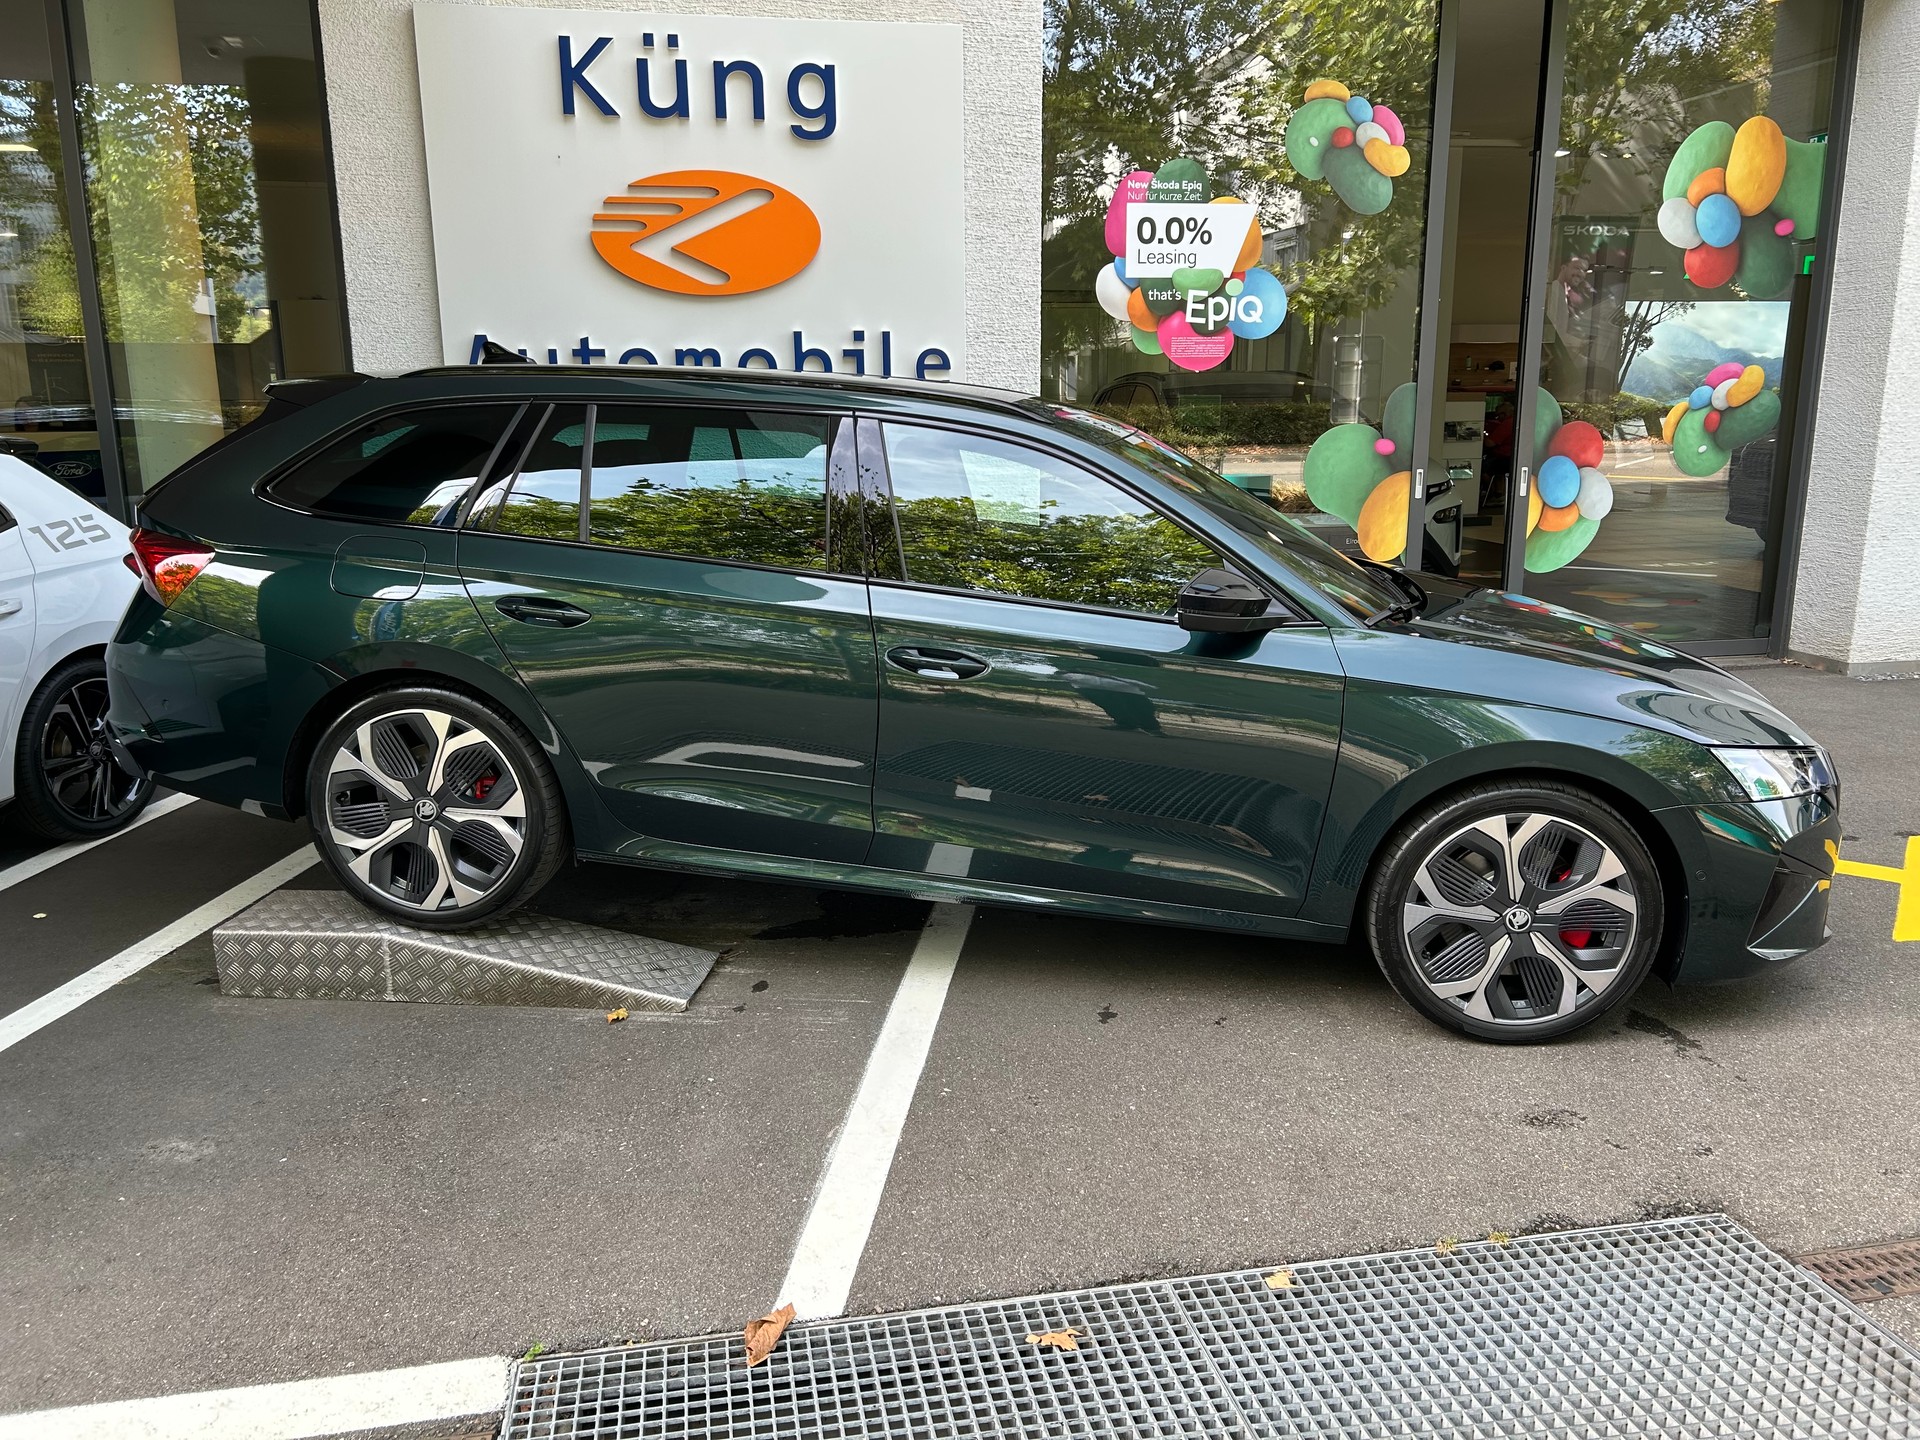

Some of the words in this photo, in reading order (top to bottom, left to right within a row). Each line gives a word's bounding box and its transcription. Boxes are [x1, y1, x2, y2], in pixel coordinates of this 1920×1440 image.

[557, 32, 838, 142] Küng
[1127, 180, 1149, 190] New
[1151, 178, 1180, 190] Škoda
[1182, 180, 1203, 192] Epiq
[1127, 191, 1144, 201] Nur
[1145, 191, 1158, 201] für
[1159, 191, 1183, 201] kurze
[1184, 191, 1203, 201] Zeit:
[1136, 216, 1213, 246] 0.0%
[1137, 248, 1198, 268] Leasing
[1148, 288, 1182, 301] that's
[55, 463, 85, 476] Ford
[27, 513, 112, 553] 125
